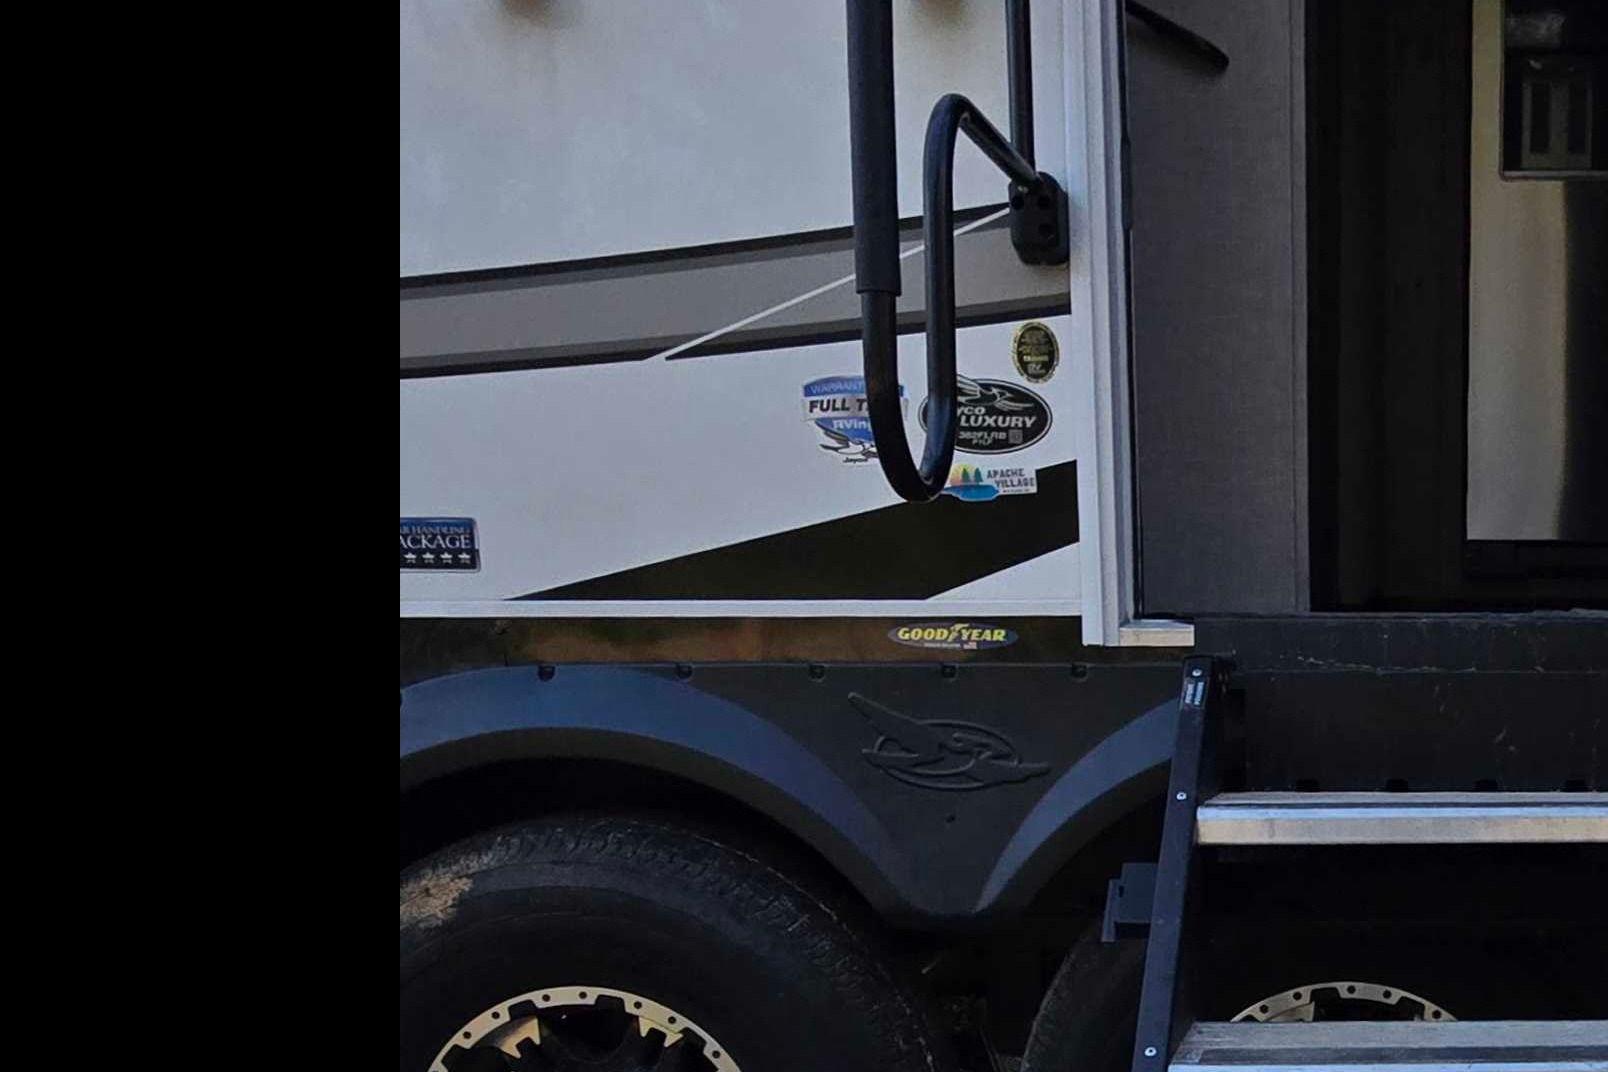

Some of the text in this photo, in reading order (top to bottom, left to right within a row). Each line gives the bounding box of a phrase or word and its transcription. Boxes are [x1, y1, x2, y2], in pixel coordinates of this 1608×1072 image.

[810, 380, 865, 394] WARRANT
[809, 398, 850, 413] FULL
[960, 414, 1037, 428] LUXURY
[986, 468, 1026, 479] APACHE
[994, 477, 1035, 488] VILLAGE
[400, 534, 472, 549] ACKAGE
[897, 623, 1006, 642] GOODYEAR
